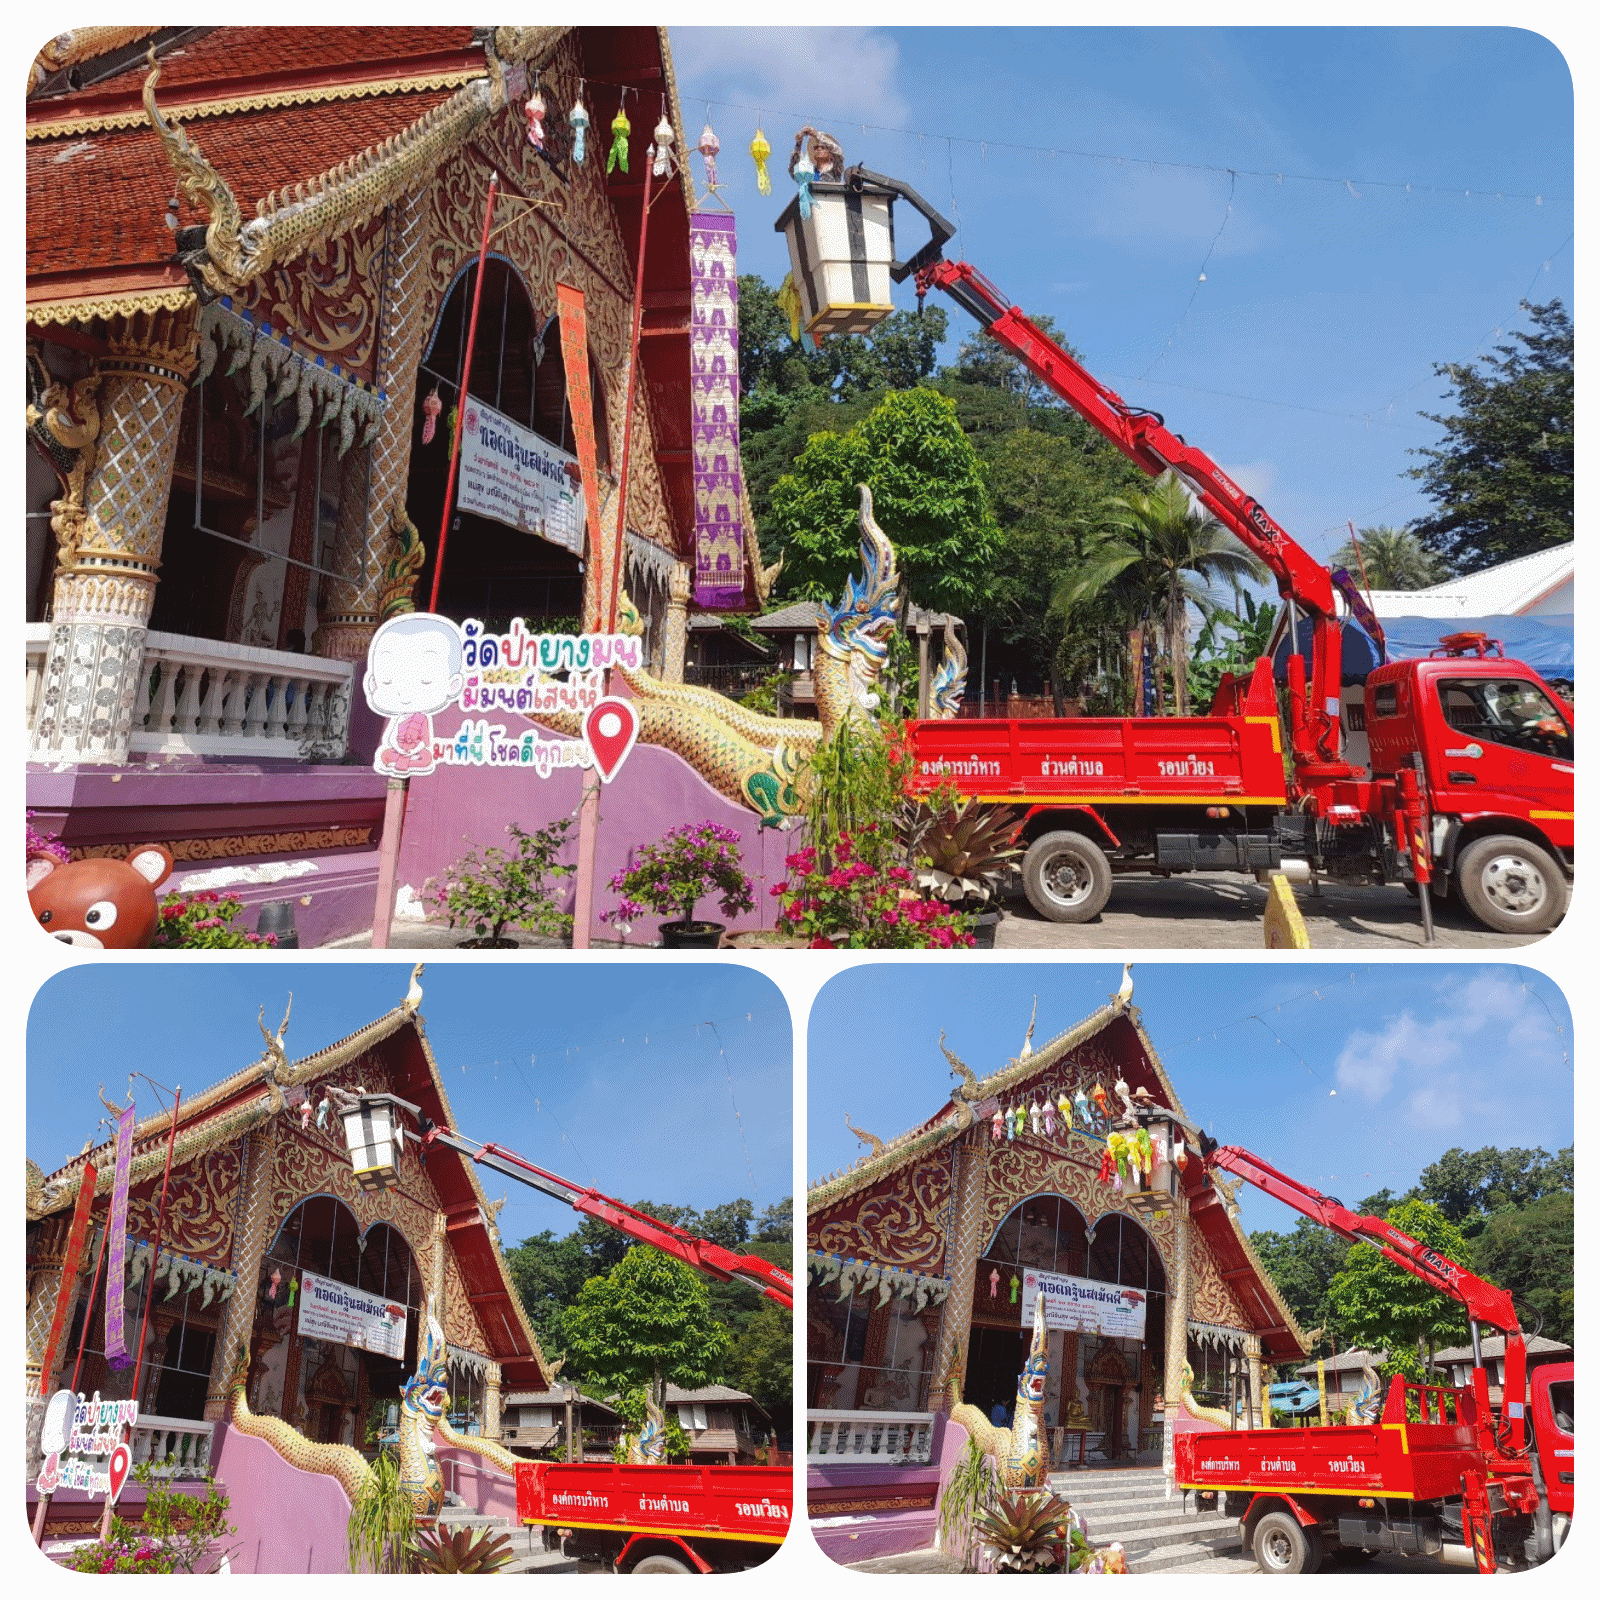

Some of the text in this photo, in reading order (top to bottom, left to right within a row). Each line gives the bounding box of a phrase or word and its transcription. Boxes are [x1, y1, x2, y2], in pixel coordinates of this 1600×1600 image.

[463, 623, 638, 668] วัดป่ายางมน
[462, 675, 598, 709] มีมนต์เสน่ห์
[1041, 755, 1104, 776] ส่วนตำบล
[1158, 754, 1214, 777] รอบเวียง
[314, 1286, 386, 1318] ทอดกฐินสามัคคี
[1038, 1281, 1121, 1305] ทอดกฐินสามัคคี
[1260, 1455, 1297, 1472] ส่วนตำบล
[1328, 1454, 1366, 1473] รอบเวียง
[552, 1490, 789, 1519] องค์การบริหาร ส่วนตำบล รอบเวียง
